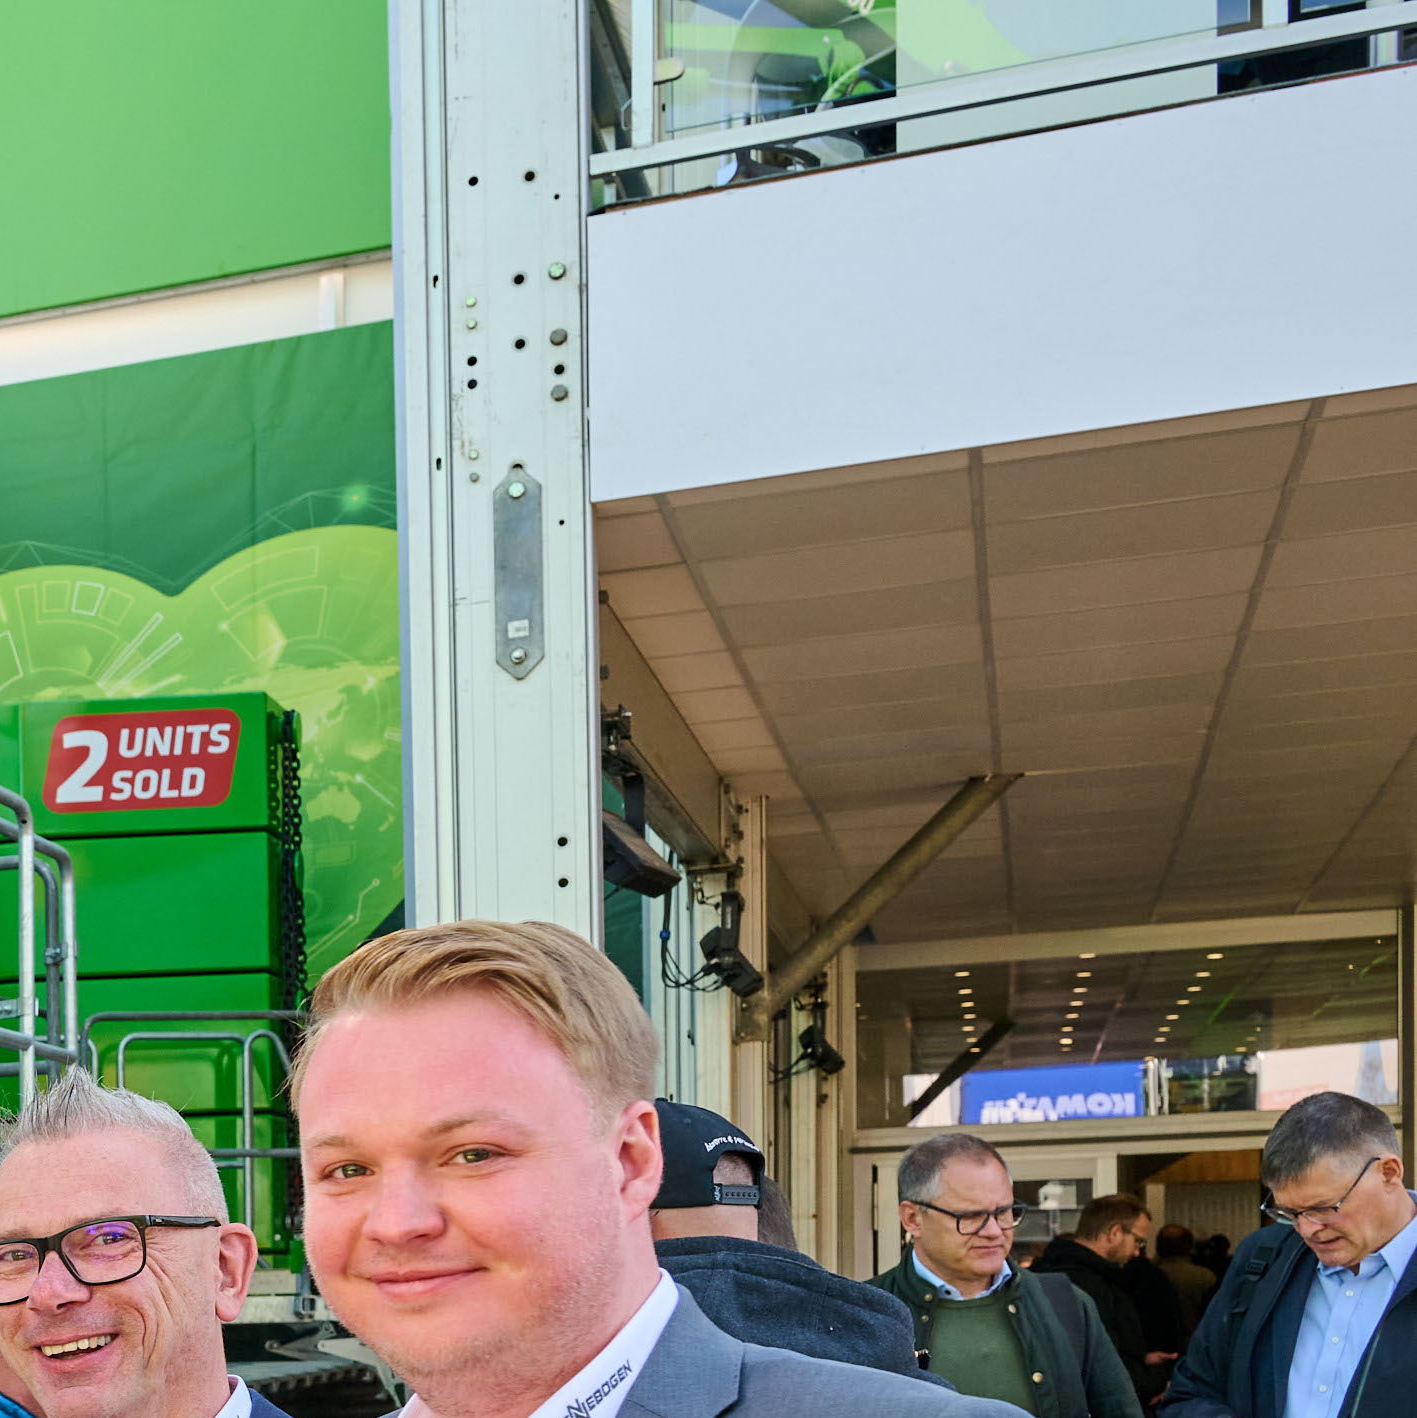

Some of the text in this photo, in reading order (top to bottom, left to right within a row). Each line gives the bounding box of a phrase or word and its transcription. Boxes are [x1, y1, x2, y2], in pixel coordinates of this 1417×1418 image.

[55, 722, 231, 804] 2 UNITS
[109, 766, 206, 801] SOLD
